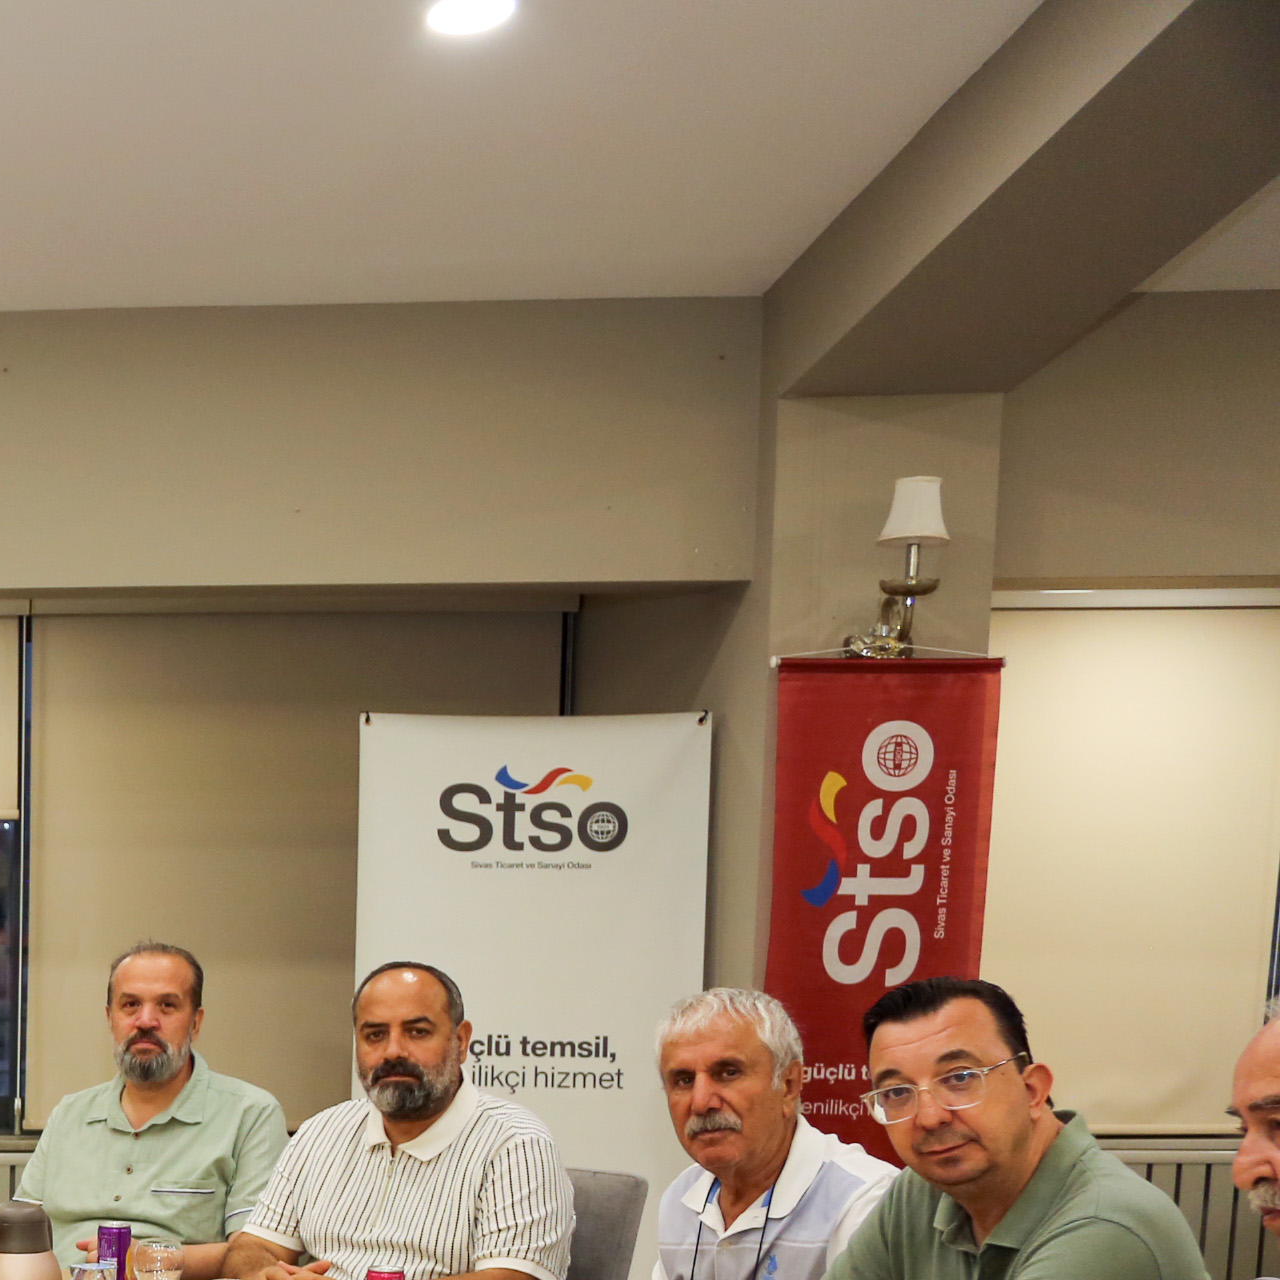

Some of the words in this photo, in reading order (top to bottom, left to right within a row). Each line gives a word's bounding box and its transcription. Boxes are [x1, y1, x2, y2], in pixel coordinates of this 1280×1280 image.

[944, 769, 957, 805] Odası
[437, 782, 629, 852] Stso
[941, 806, 956, 846] Sanayi
[471, 861, 493, 869] Sivas
[495, 861, 524, 869] Ticaret
[537, 861, 565, 870] Sanayi
[567, 861, 592, 869] Odası
[822, 720, 934, 987] Stso
[942, 848, 951, 862] ve
[937, 864, 950, 905] Ticaret
[934, 907, 946, 939] Sivas
[469, 1034, 511, 1063] çlü
[520, 1035, 616, 1063] temsil,
[472, 1065, 526, 1094] ilikçi
[534, 1066, 624, 1090] hizmet
[802, 1063, 856, 1084] güçlü
[801, 1099, 864, 1120] enilikçi
